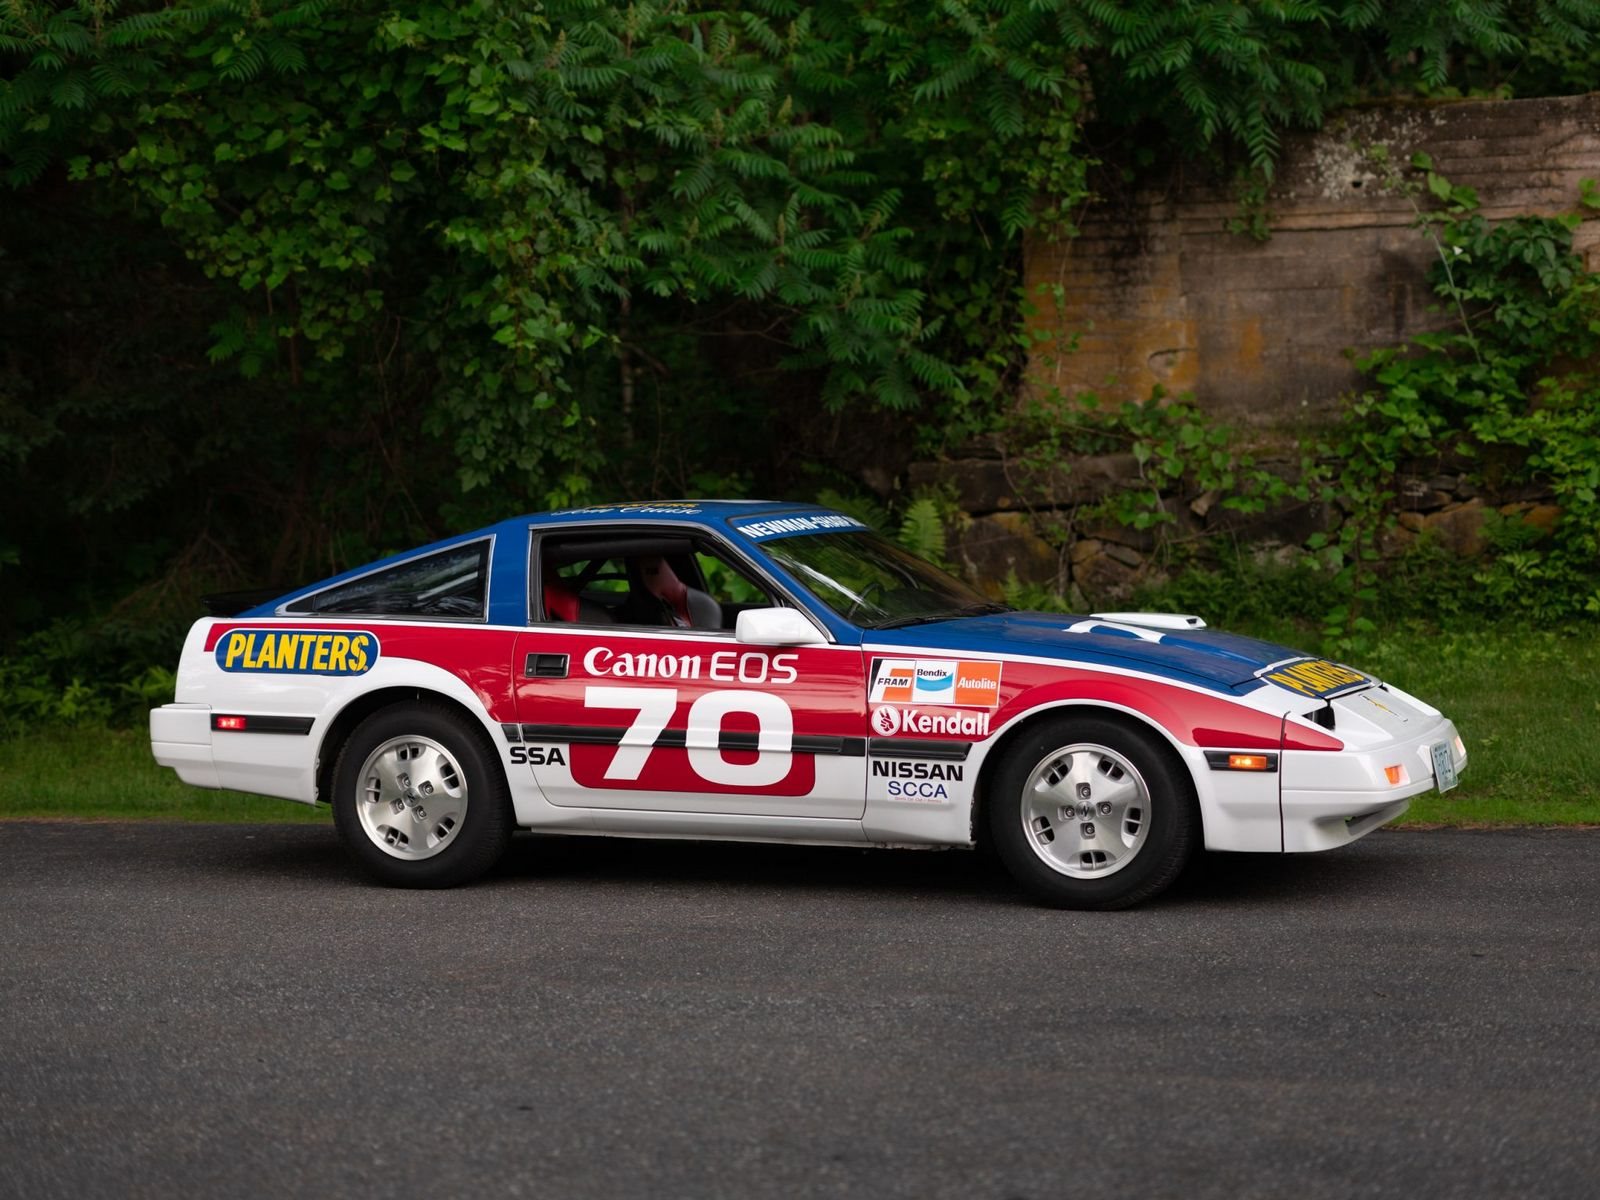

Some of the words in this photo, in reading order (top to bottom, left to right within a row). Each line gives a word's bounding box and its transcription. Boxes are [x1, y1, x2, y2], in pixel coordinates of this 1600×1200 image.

[225, 633, 370, 672] PLANTERS
[583, 646, 701, 679] Canon
[709, 651, 799, 684] EOS
[917, 668, 947, 677] Bendix
[877, 677, 909, 687] FRAM
[957, 677, 997, 690] Autolite
[902, 709, 990, 736] Kendall
[583, 686, 794, 787] 70
[509, 746, 566, 766] SSA
[872, 760, 964, 782] NISSAN
[887, 780, 949, 799] SCCA
